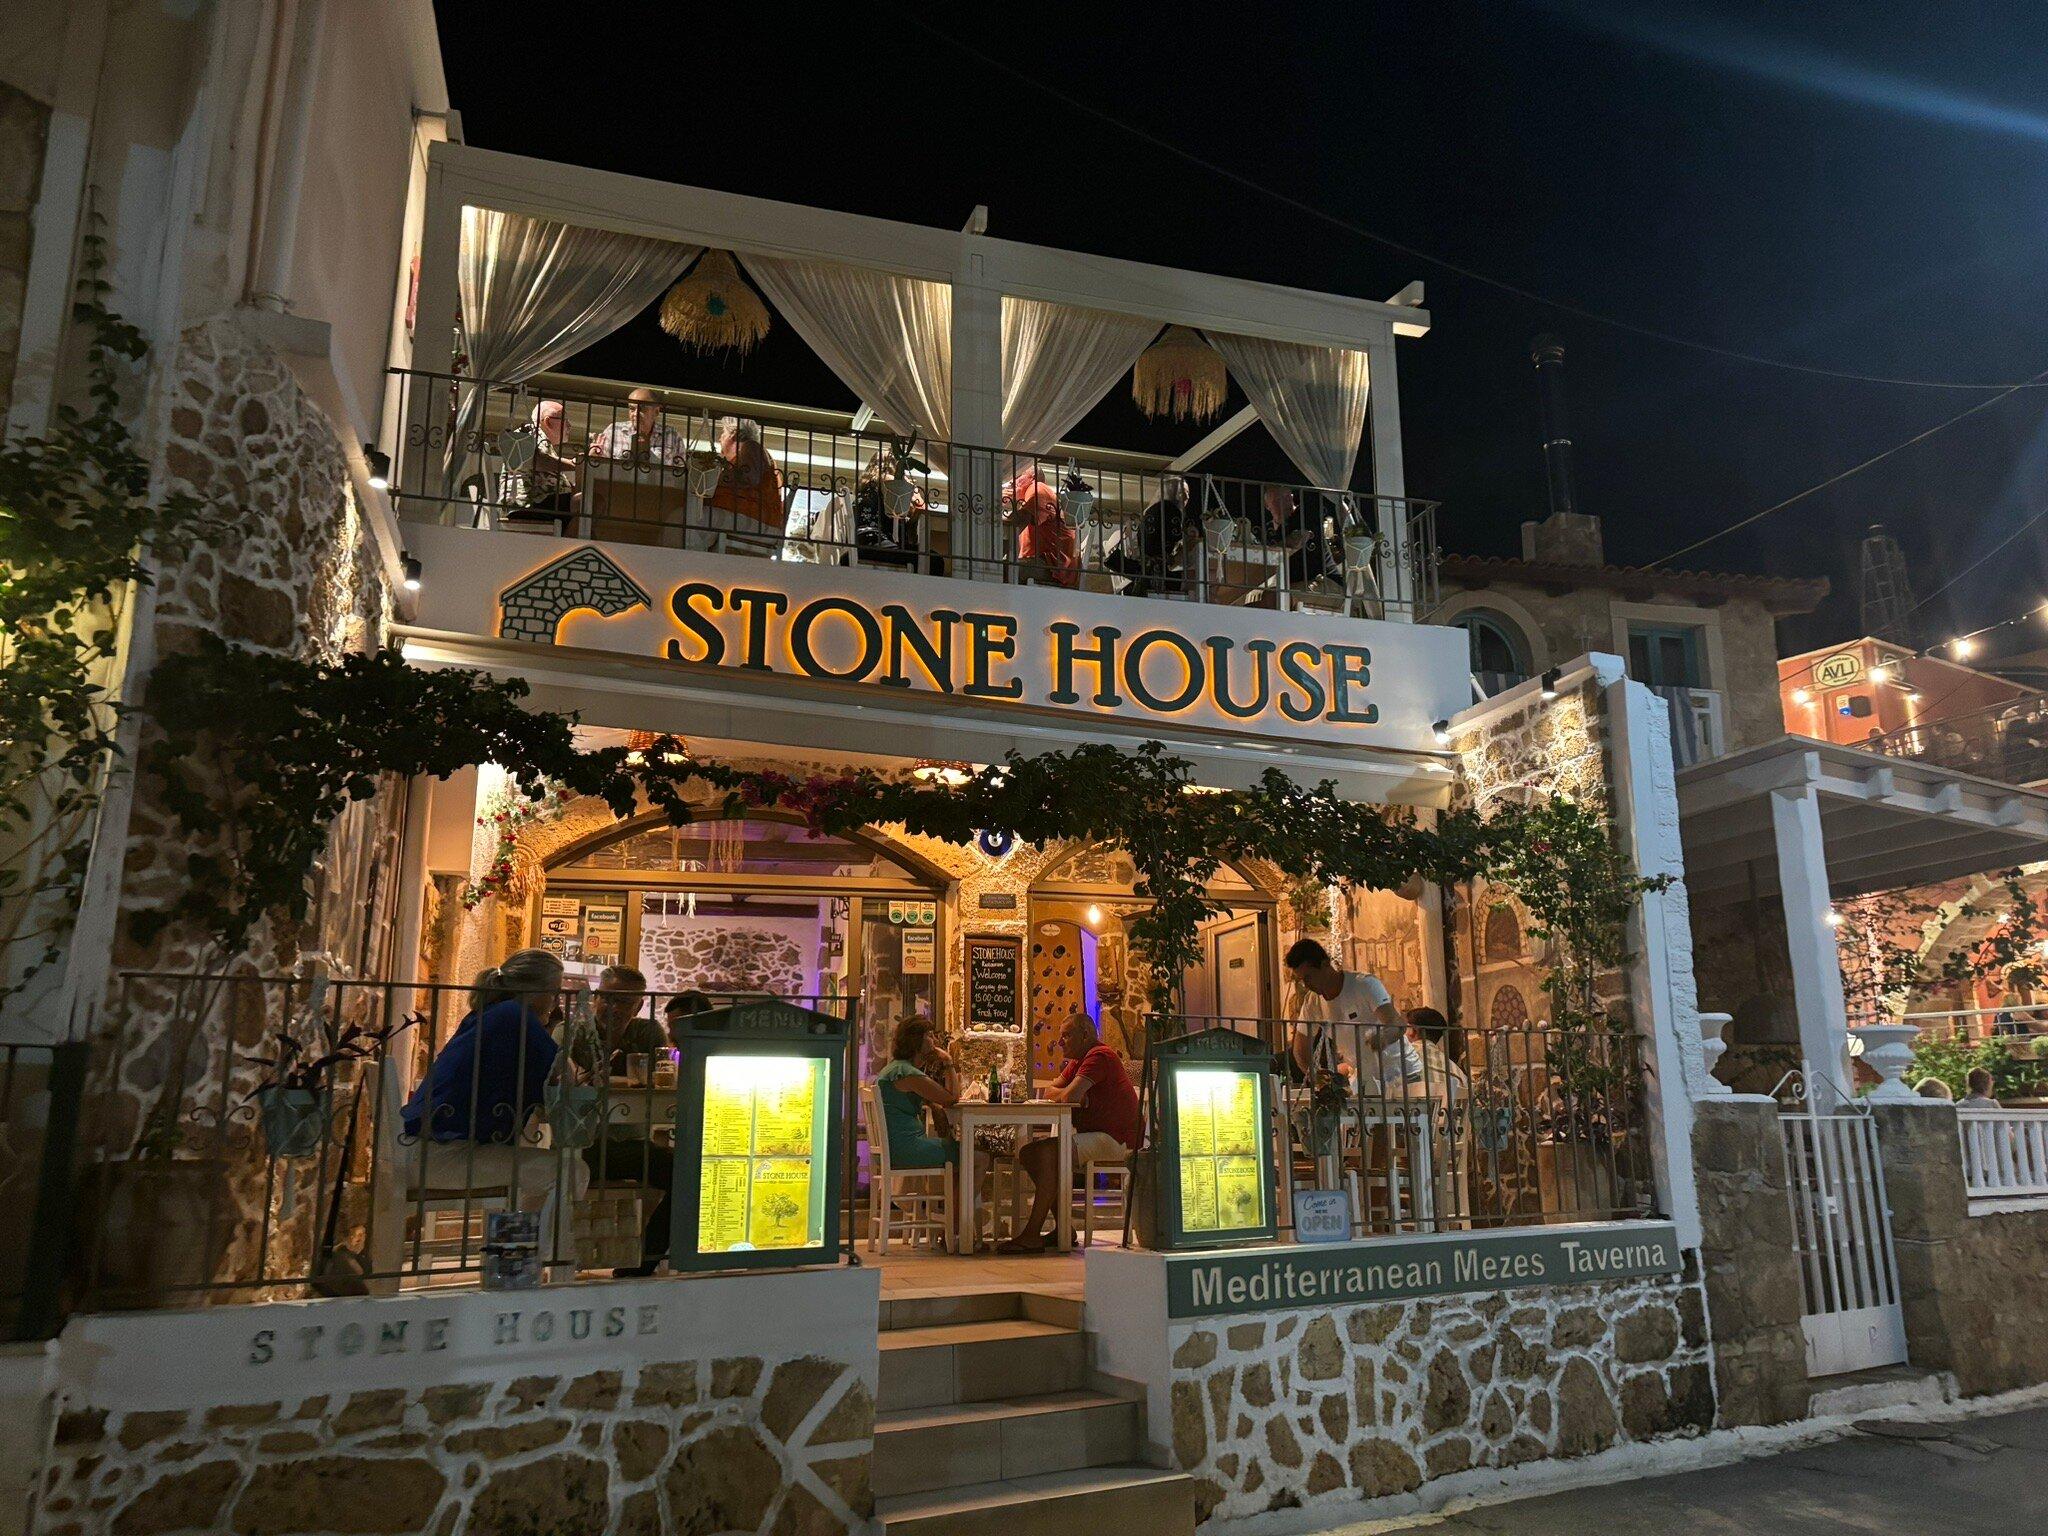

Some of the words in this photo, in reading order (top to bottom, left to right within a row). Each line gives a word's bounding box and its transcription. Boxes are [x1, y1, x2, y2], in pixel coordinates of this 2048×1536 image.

[667, 583, 1023, 699] STONE
[1050, 622, 1379, 724] HOUSE
[1822, 661, 1854, 680] AVLI
[591, 912, 617, 920] facebook
[975, 968, 1007, 980] Welcome
[993, 1008, 1007, 1018] Food
[1301, 1215, 1343, 1231] OPEN
[1191, 1258, 1442, 1307] Mediterranean
[1453, 1248, 1545, 1283] Mezes
[1560, 1240, 1667, 1275] Taverna
[494, 1304, 660, 1346] HOUSE
